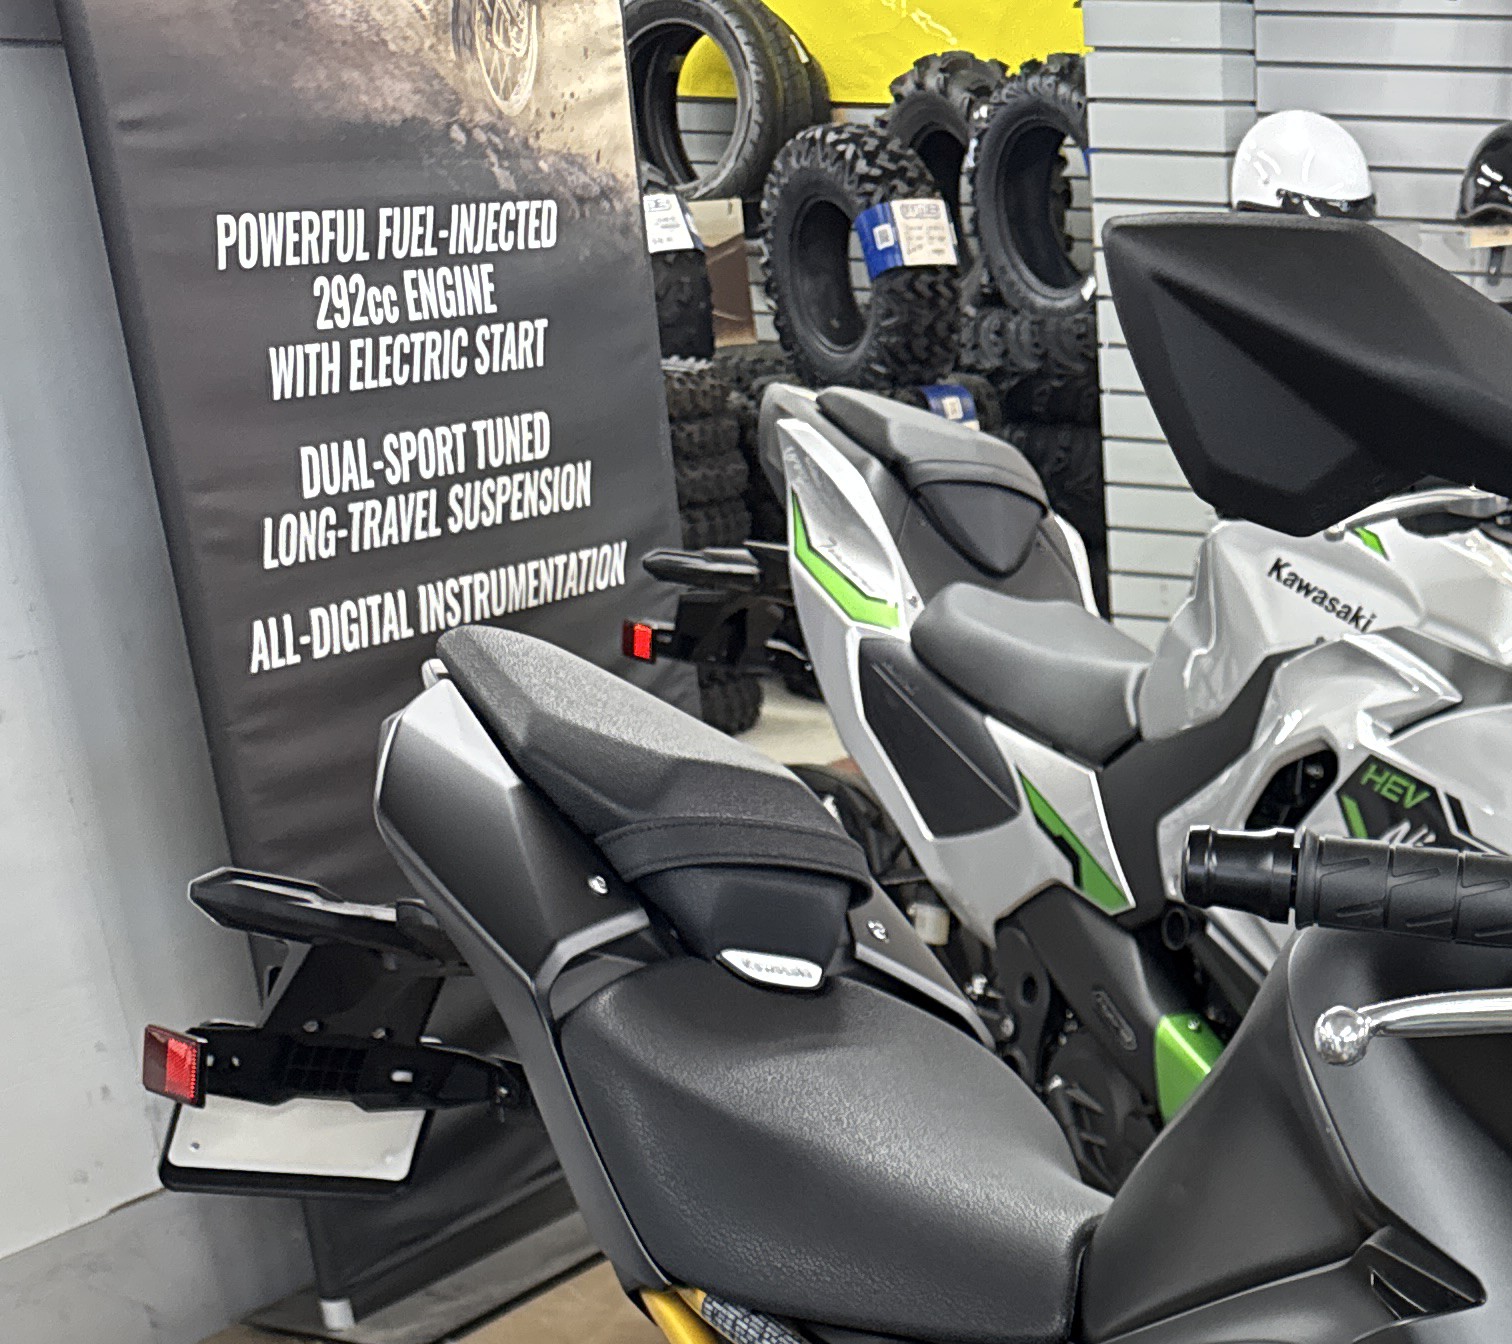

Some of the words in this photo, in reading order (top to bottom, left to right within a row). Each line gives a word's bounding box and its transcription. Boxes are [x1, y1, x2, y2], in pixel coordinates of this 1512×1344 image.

[216, 209, 369, 270] POWERFUL
[377, 200, 557, 260] FUEL-INJECTED
[313, 274, 399, 330] 292cc
[403, 264, 497, 321] ENGINE
[269, 341, 340, 400] WITH
[350, 327, 468, 391] ELECTRIC
[475, 318, 548, 374] START
[300, 423, 466, 499] DUAL-SPORT
[472, 411, 550, 470] TUNED
[263, 488, 441, 570] LONG-TRAVEL
[448, 461, 592, 534] SUSPENSION
[250, 590, 414, 673] ALL-DIGITAL
[418, 541, 628, 634] INSTRUMENTATION
[1267, 557, 1377, 633] Kawasaki
[1360, 764, 1430, 808] HEV
